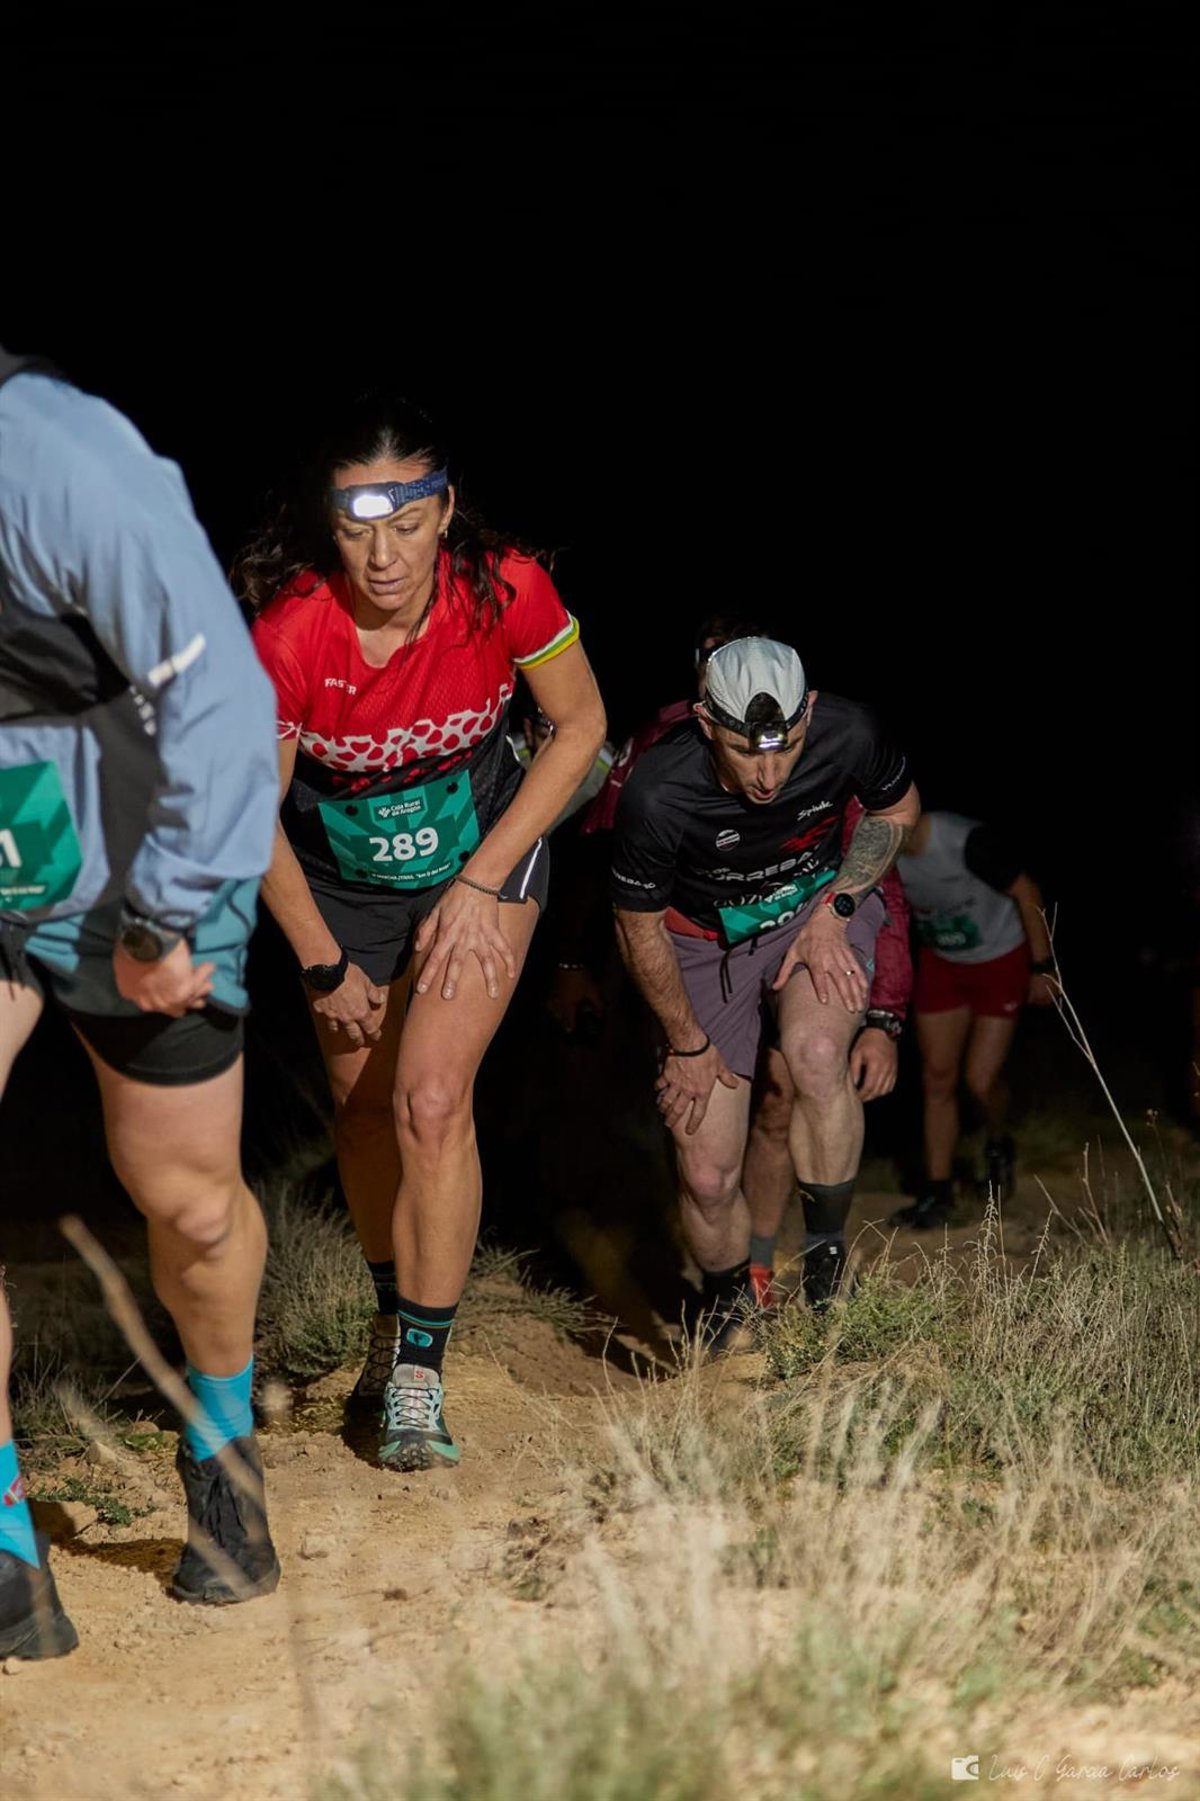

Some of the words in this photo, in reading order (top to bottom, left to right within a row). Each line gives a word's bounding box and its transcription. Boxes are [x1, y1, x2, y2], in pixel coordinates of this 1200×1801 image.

[324, 677, 357, 695] FASR
[0, 828, 22, 868] 1
[368, 826, 439, 862] 289
